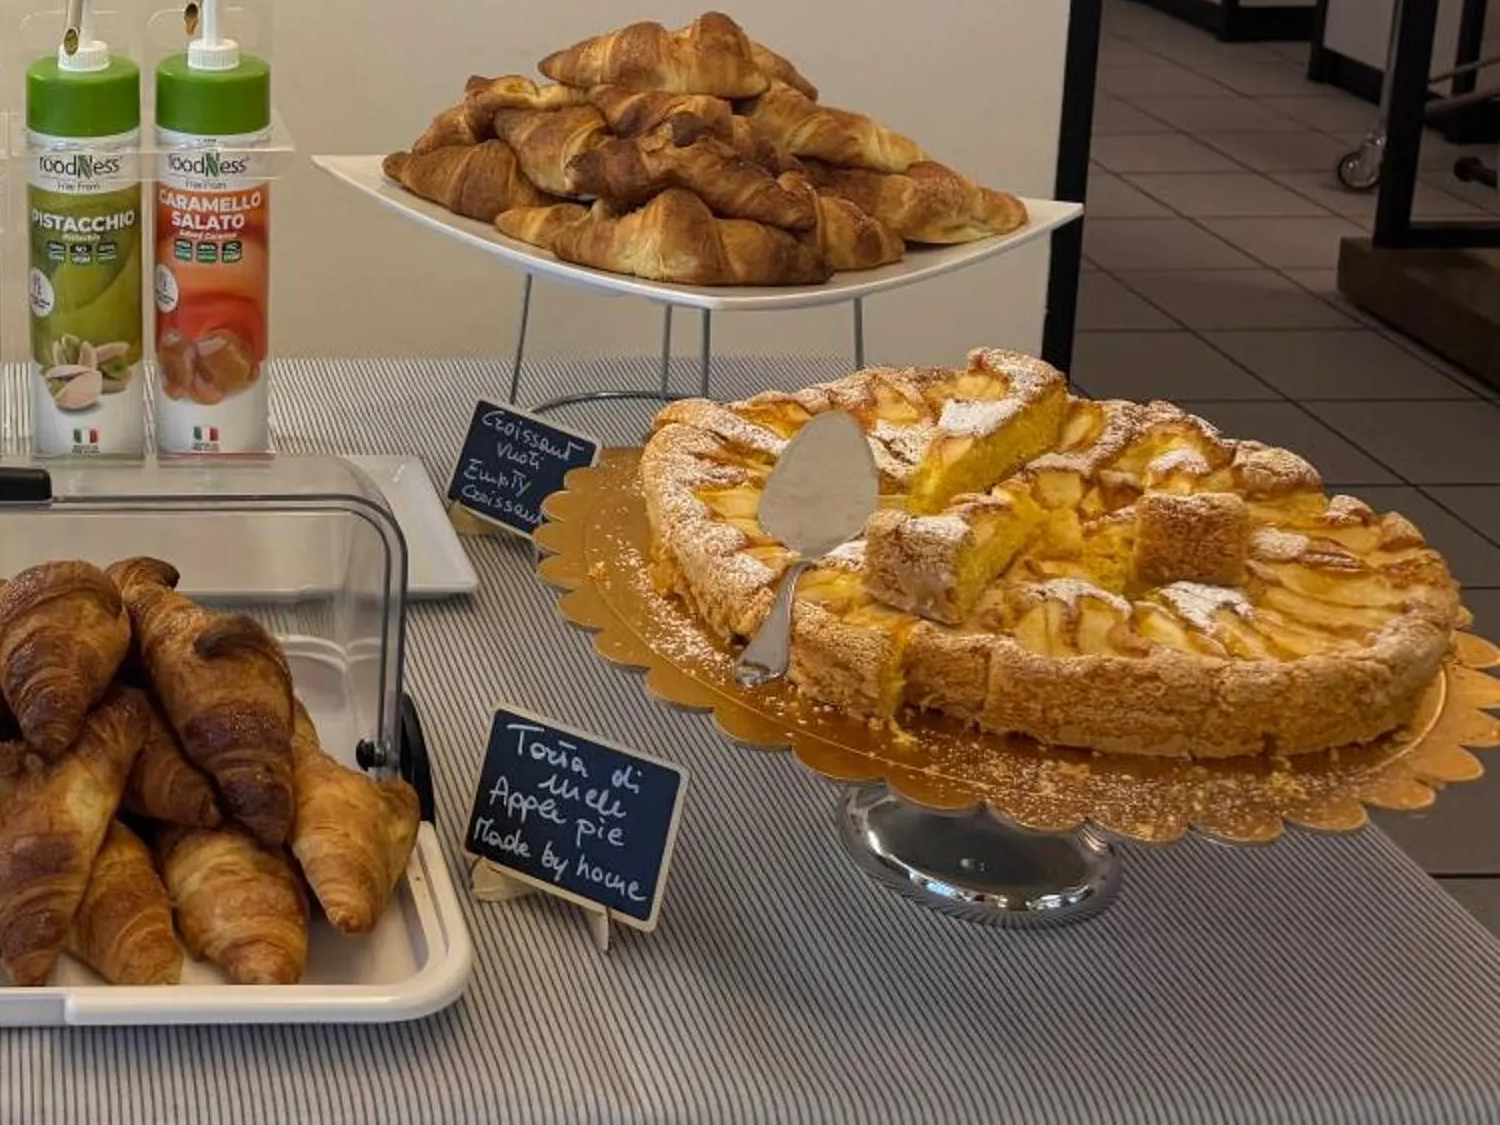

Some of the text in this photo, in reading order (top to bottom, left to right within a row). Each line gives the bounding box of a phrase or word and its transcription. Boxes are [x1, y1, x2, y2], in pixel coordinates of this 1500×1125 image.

[159, 189, 261, 213] CARAMELLO
[171, 210, 245, 231] SALATO
[611, 764, 643, 795] di
[575, 817, 626, 847] pie
[541, 840, 570, 883] by
[575, 854, 648, 902] home
